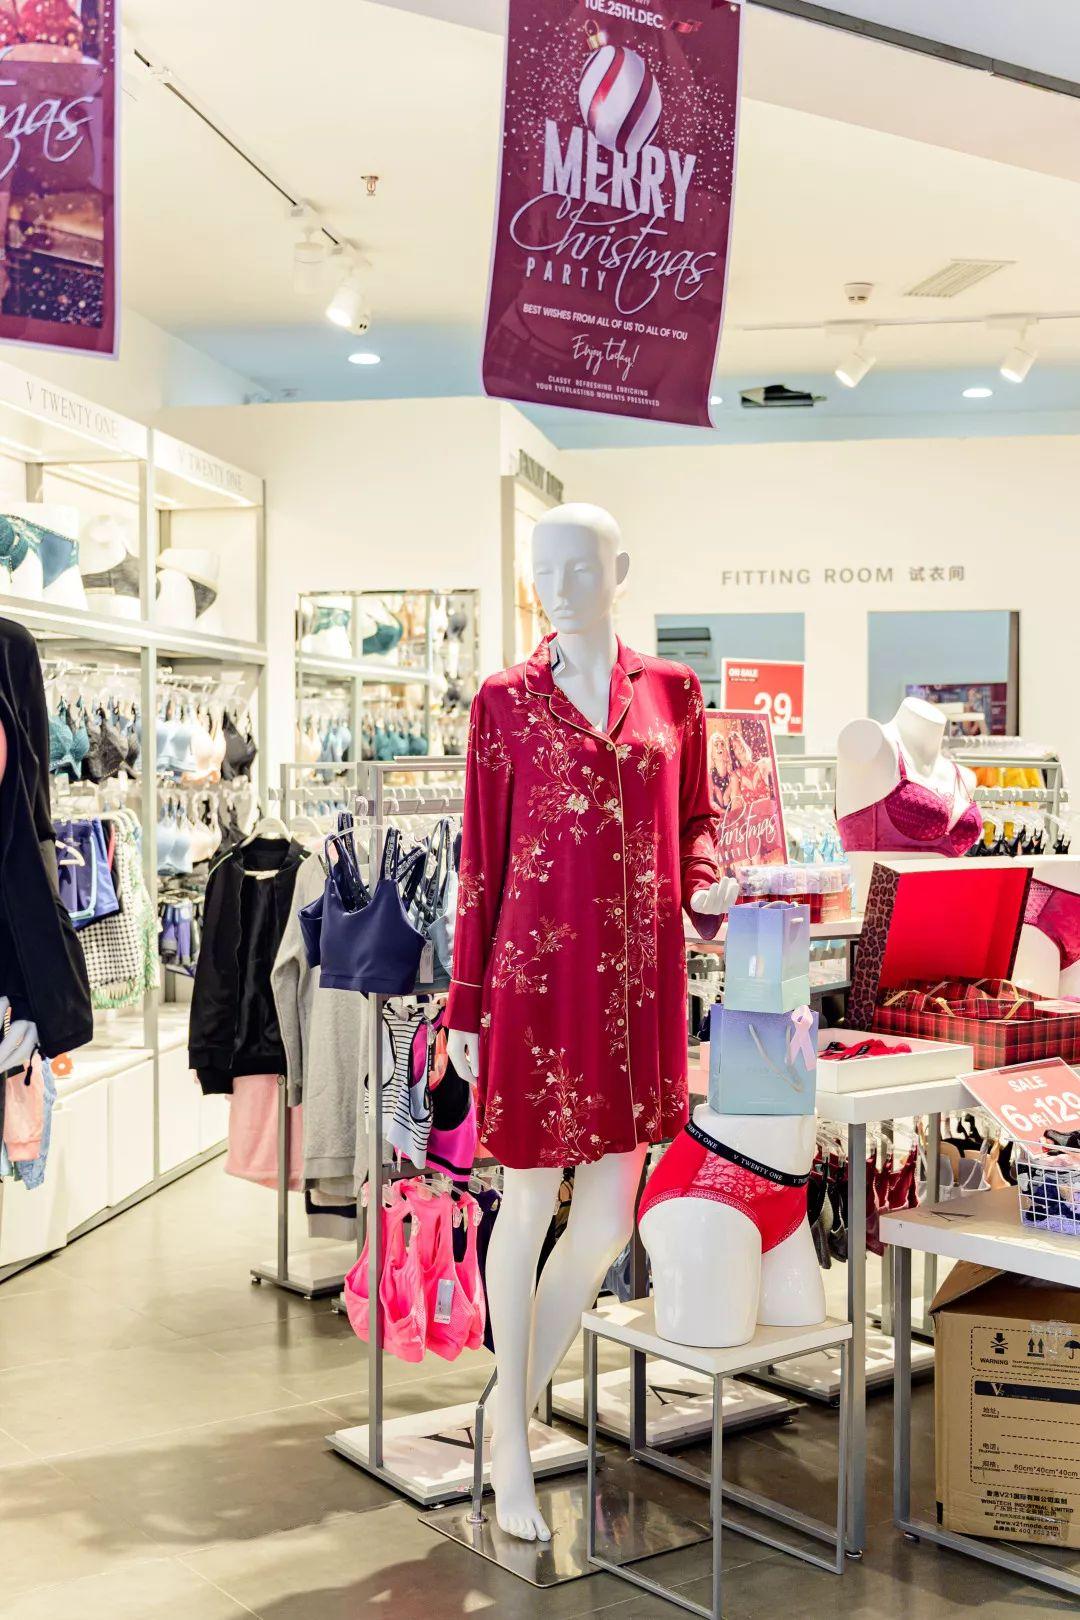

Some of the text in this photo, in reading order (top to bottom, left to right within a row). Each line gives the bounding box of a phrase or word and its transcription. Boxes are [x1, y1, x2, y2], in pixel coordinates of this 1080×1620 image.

[542, 117, 697, 222] MERRY
[509, 177, 717, 315] Christmas
[526, 256, 607, 292] PARTY
[523, 303, 689, 341] BEST WISHES FROM ALL OF US TO ALL OF YOU
[571, 333, 640, 382] Enjoy today!
[535, 382, 553, 392] YOUR
[554, 385, 595, 398] EVERLASTING
[548, 375, 571, 386] CLASSY
[25, 381, 119, 440] V TWENTY ONE
[721, 565, 966, 586] FITTING ROOM 试衣间
[1008, 1075, 1049, 1093] SALE
[703, 1136, 718, 1150] ONE
[740, 1157, 769, 1176] TWENTY
[769, 1171, 783, 1181] ONE
[980, 1357, 1009, 1366] WARNING
